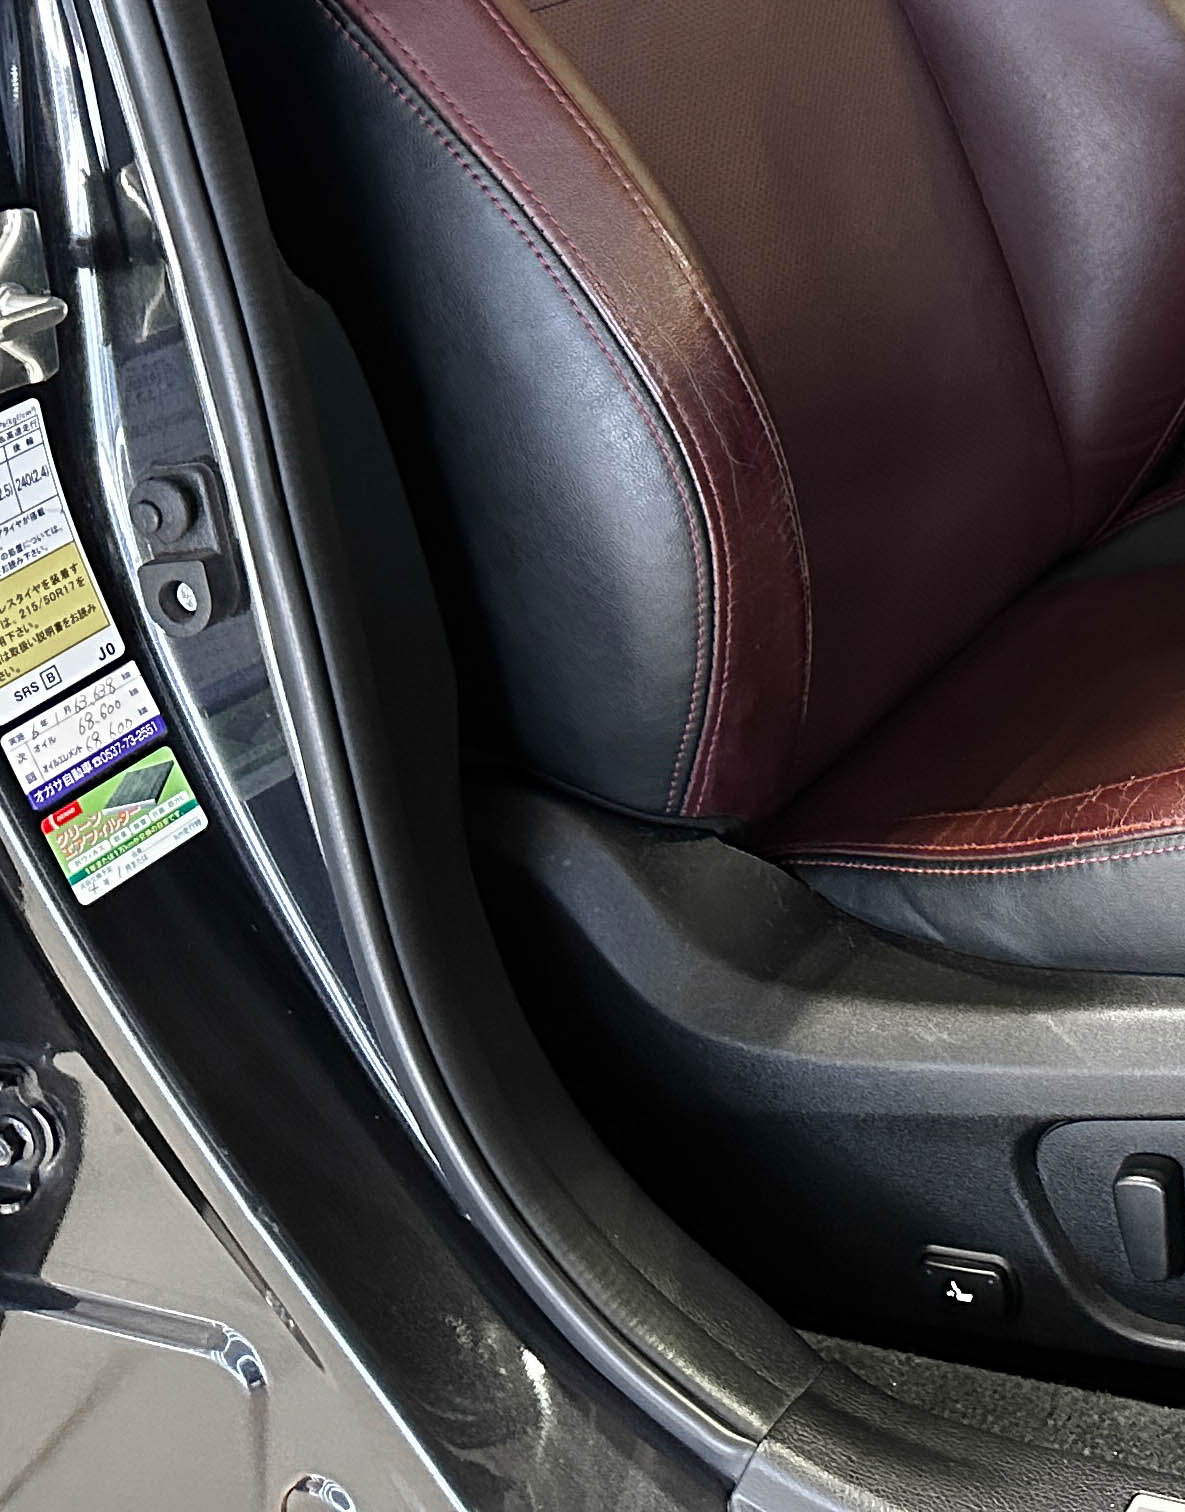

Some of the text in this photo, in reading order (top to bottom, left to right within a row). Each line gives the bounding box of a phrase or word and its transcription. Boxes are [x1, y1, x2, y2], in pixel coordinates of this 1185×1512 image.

[15, 464, 49, 492] 240(2.4)
[0, 507, 45, 536] タイヤが搭載
[0, 546, 48, 576] お読み下さい。
[0, 603, 96, 665] は取扱い説明書をお読み
[14, 682, 39, 702] SRS
